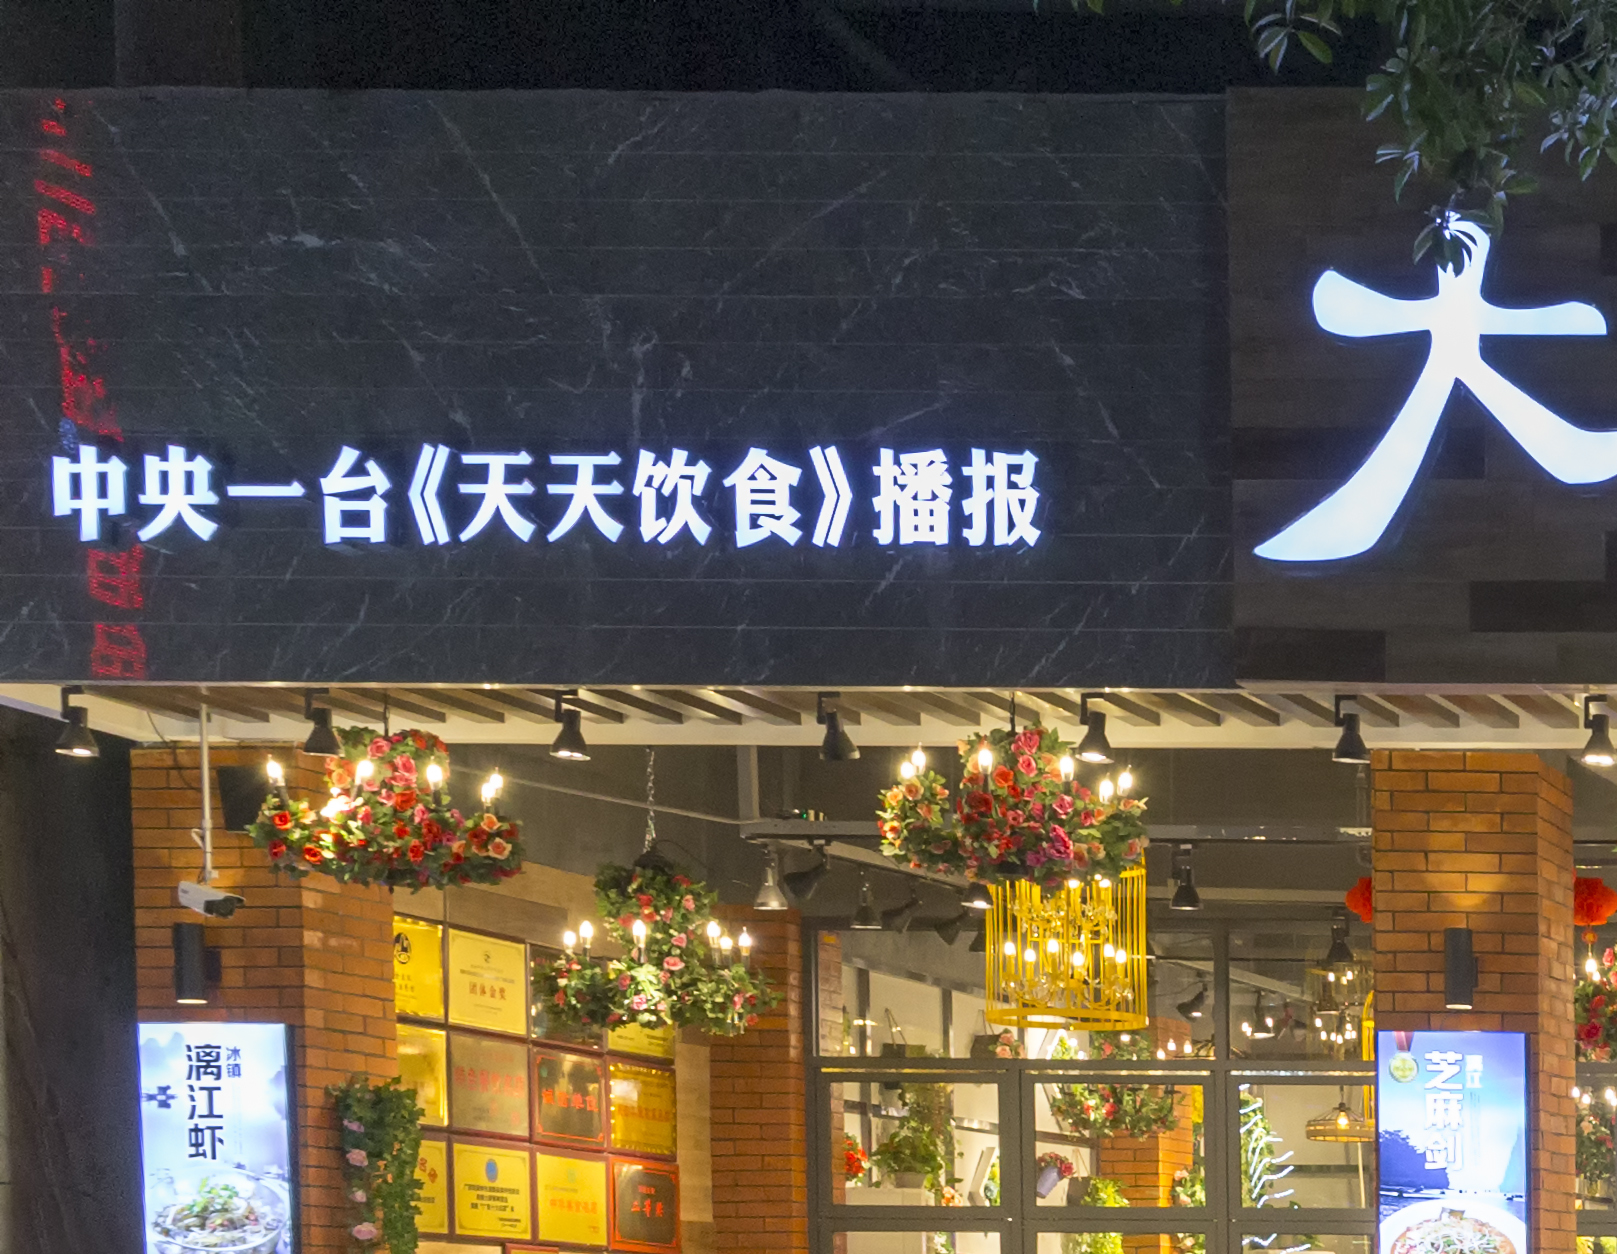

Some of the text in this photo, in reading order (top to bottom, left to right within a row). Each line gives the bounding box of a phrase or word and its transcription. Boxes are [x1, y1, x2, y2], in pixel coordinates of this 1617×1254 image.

[51, 443, 1042, 549] 中央一台《天天饮食》播报
[185, 1044, 224, 1160] 漓江虾
[1423, 1050, 1464, 1171] 芝麻剑
